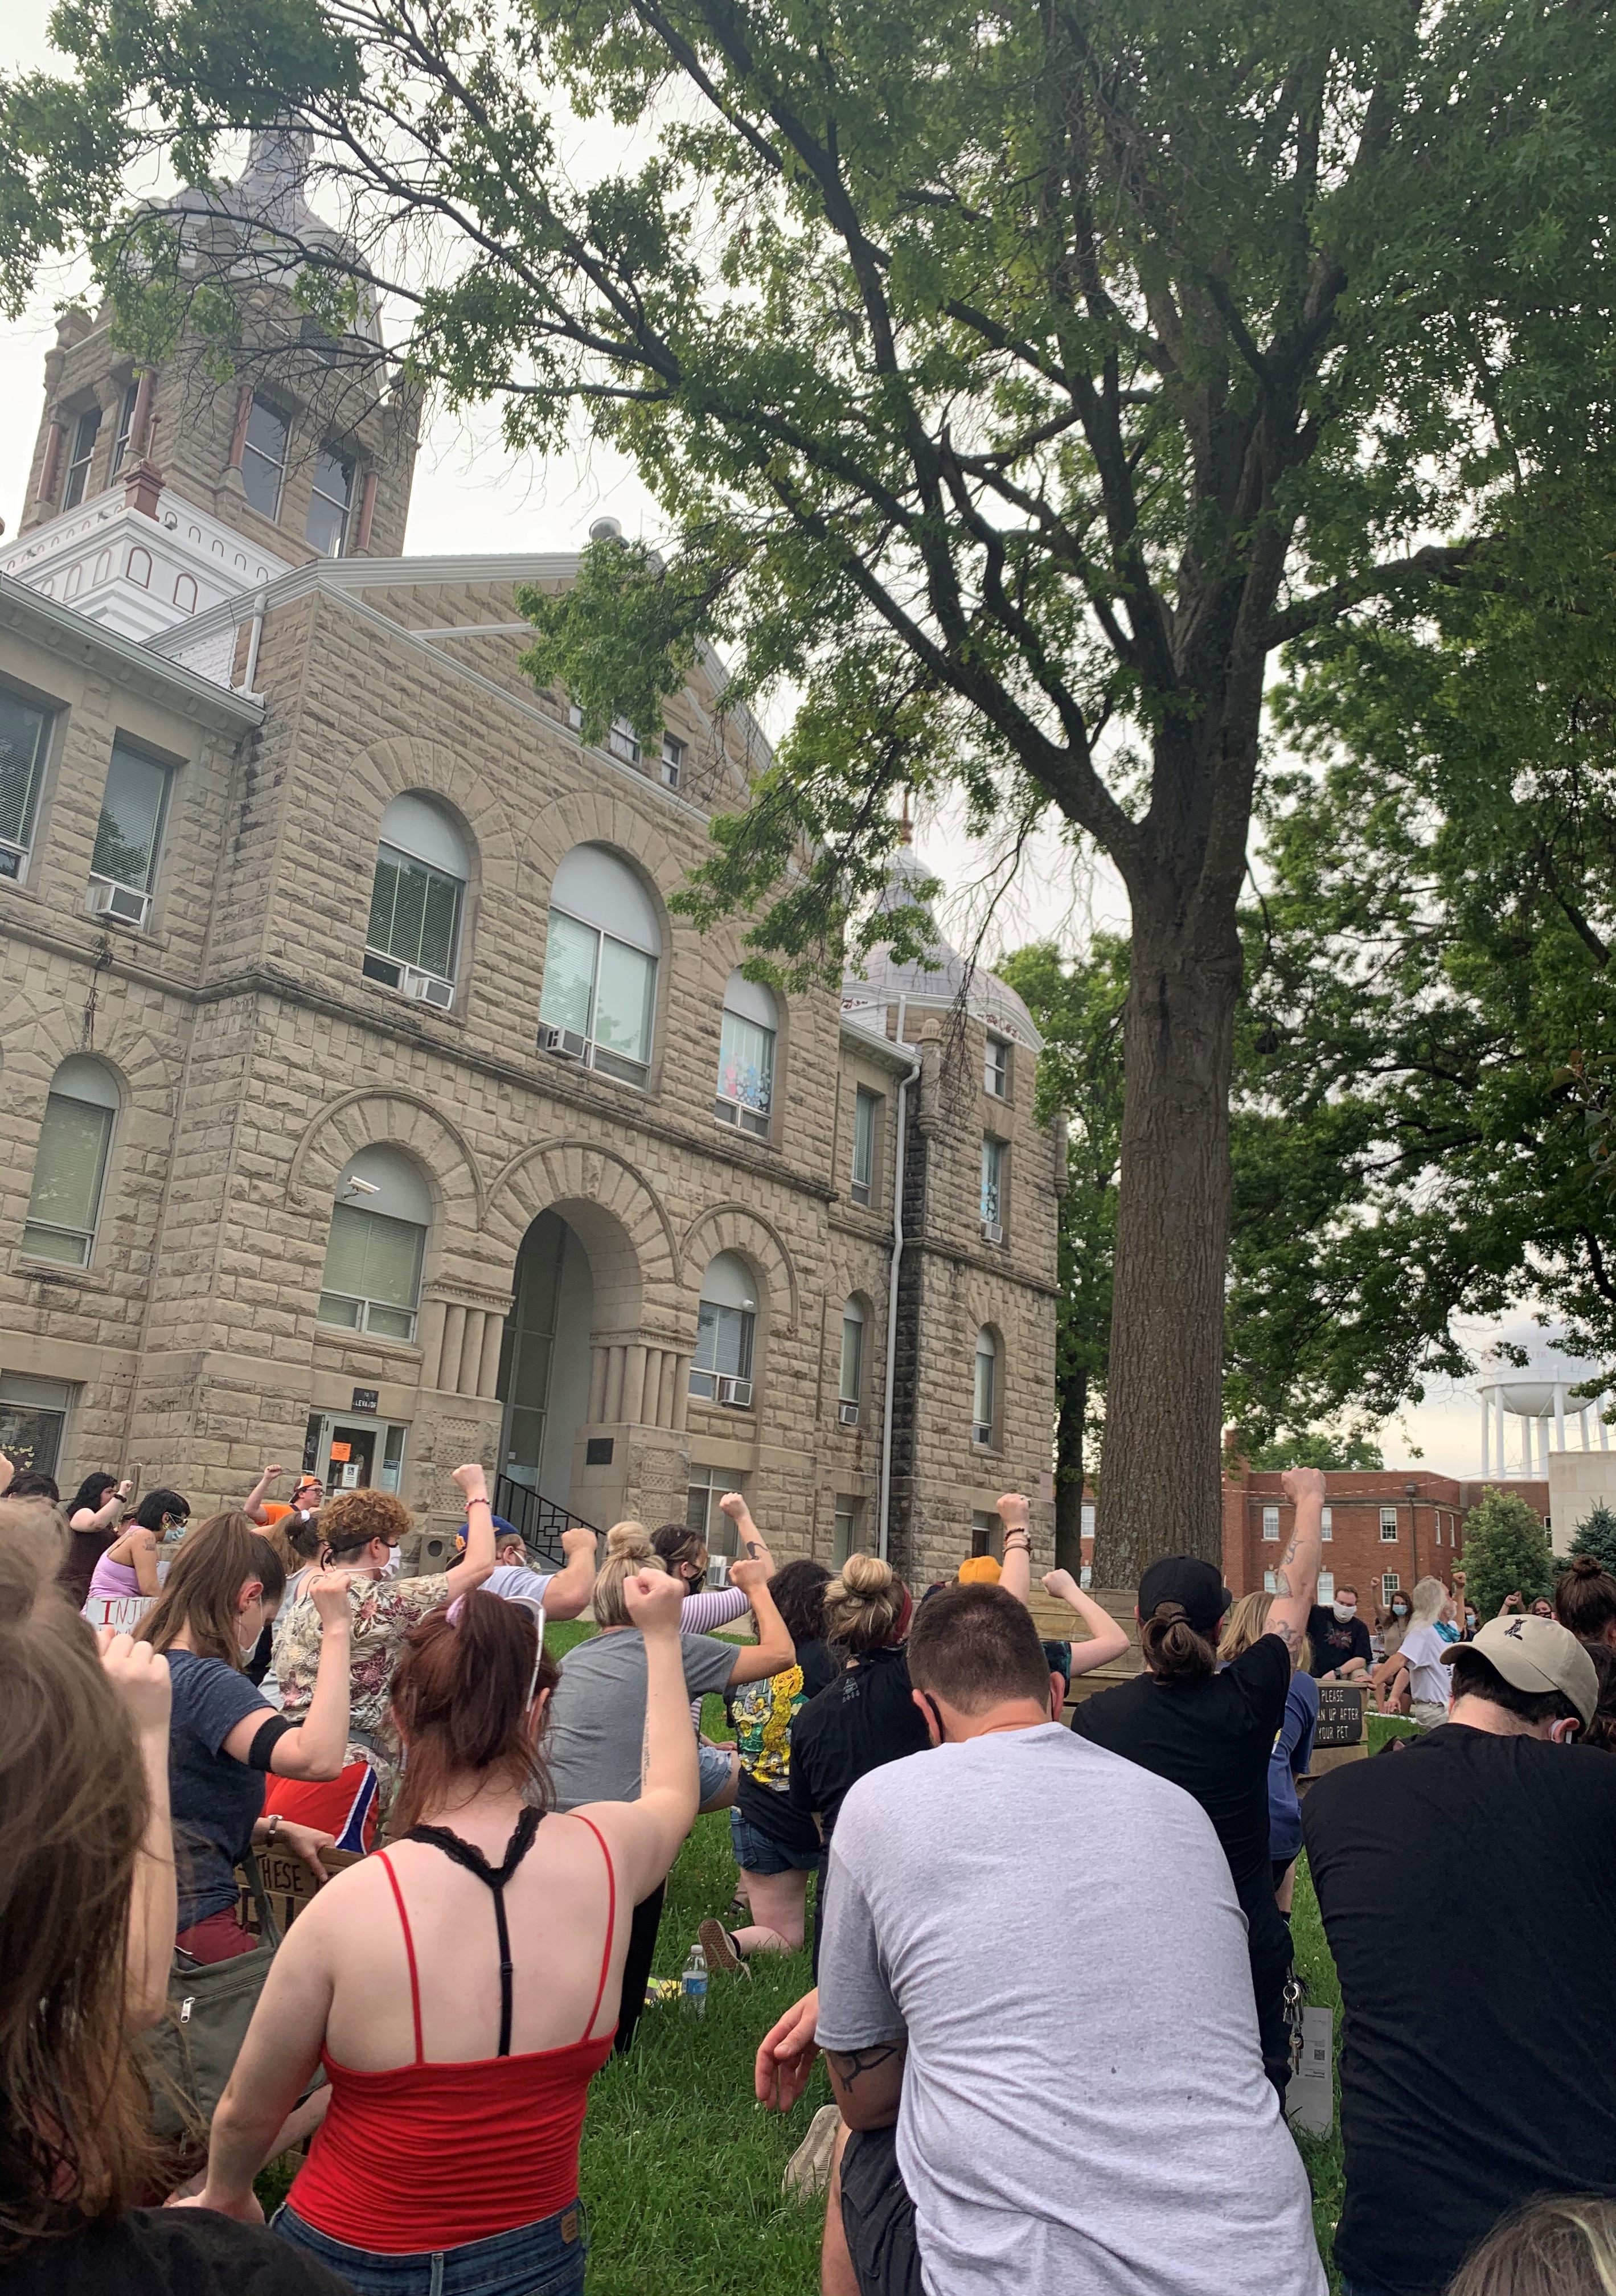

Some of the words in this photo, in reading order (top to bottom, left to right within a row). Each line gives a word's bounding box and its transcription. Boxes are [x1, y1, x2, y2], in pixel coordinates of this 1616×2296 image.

[1321, 1690, 1344, 1703] PLEASE
[1328, 1708, 1336, 1721] UP
[1340, 1708, 1359, 1720] AFTER
[1318, 1726, 1334, 1740] YOUR
[1336, 1725, 1349, 1739] PET
[256, 1854, 304, 1892] HESE
